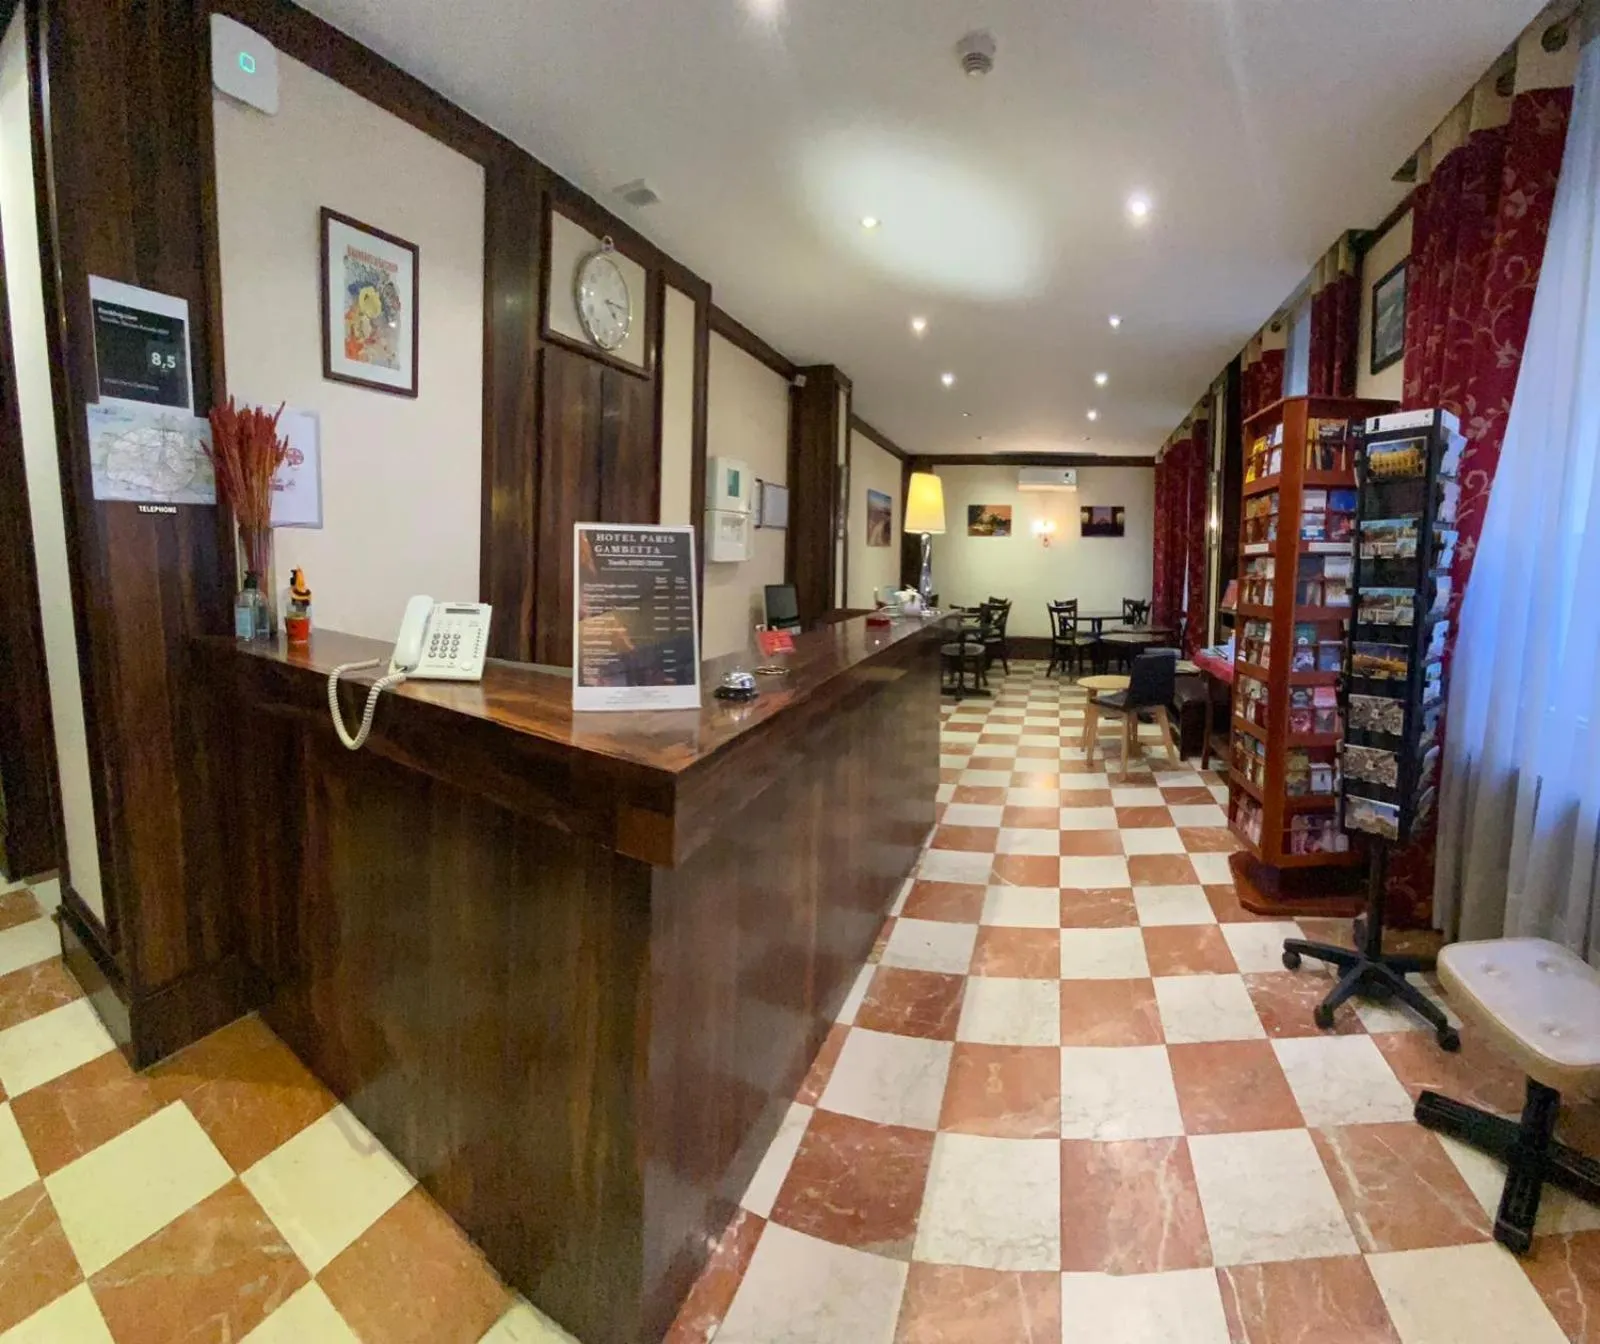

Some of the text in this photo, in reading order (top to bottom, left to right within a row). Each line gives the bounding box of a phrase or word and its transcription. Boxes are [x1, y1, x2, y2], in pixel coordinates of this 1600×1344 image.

[151, 352, 176, 368] 8,5
[138, 504, 177, 513] TELEPHONE
[596, 533, 676, 544] HOTEL PARIS
[594, 545, 661, 554] GAMBETTA
